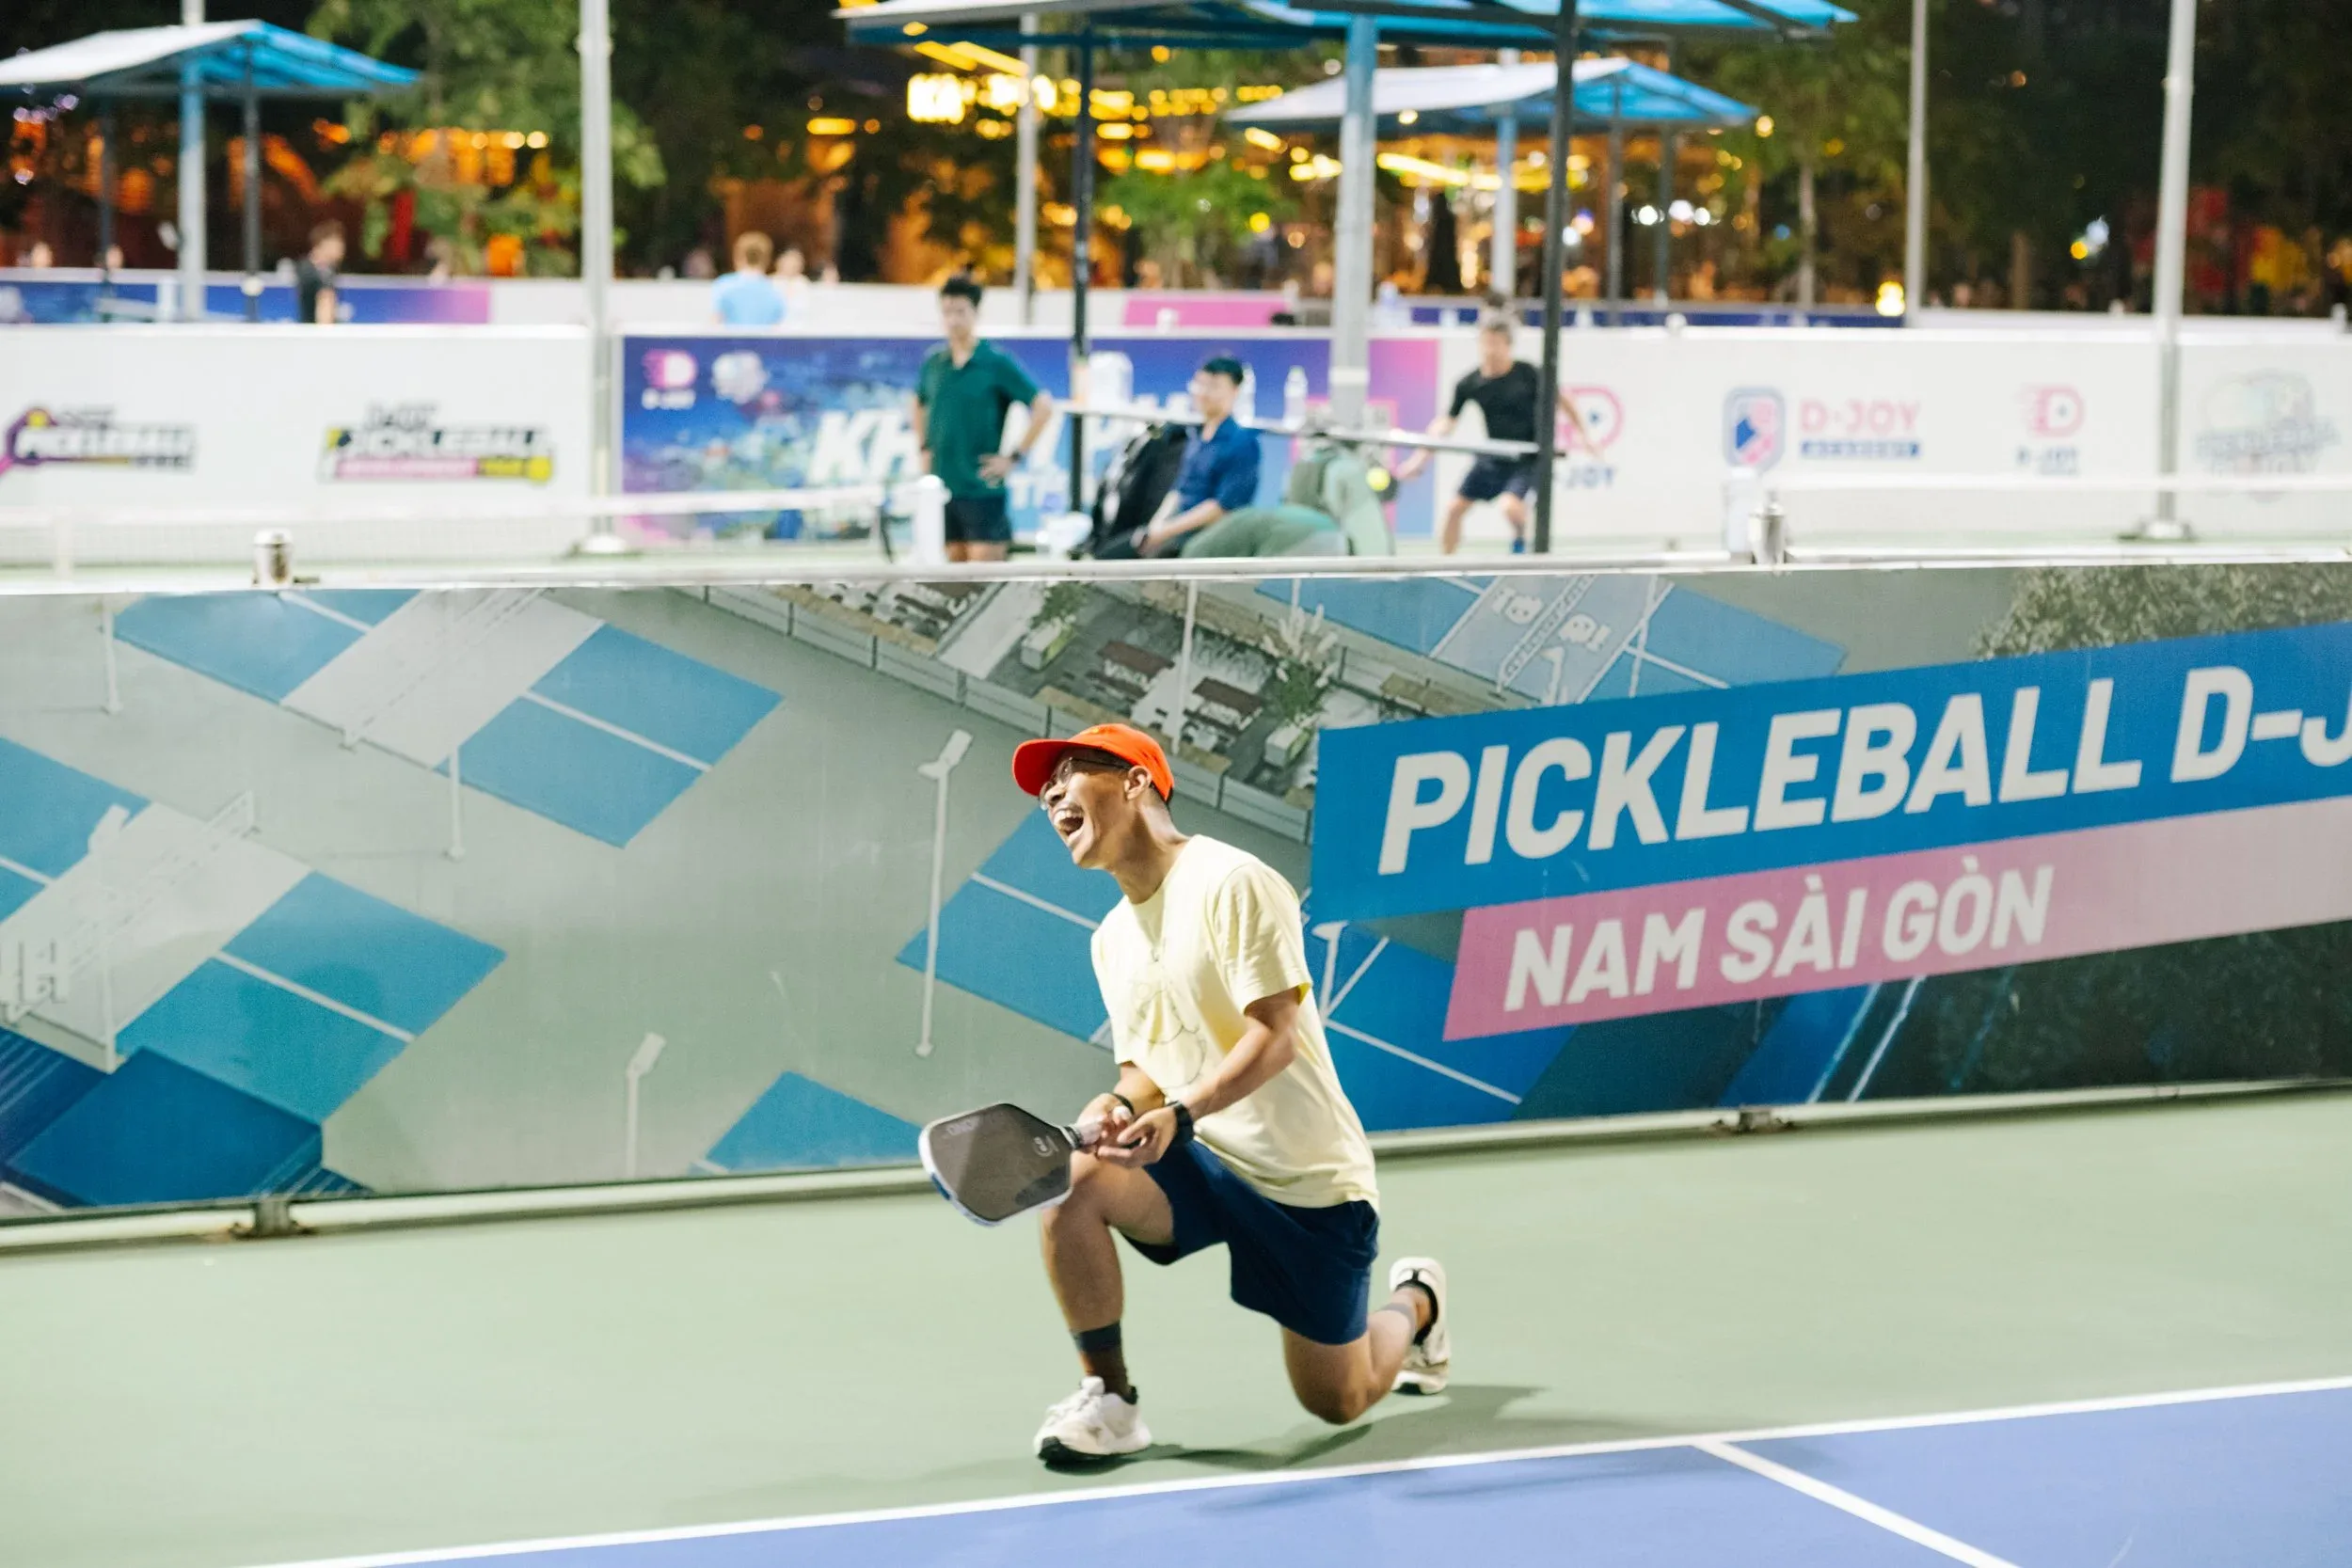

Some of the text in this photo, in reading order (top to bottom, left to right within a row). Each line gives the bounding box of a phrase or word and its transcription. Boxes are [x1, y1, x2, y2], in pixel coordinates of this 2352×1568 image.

[1378, 678, 2142, 875] PICKLEBALL
[1505, 856, 2055, 1012] NAM SÀI GÒN
